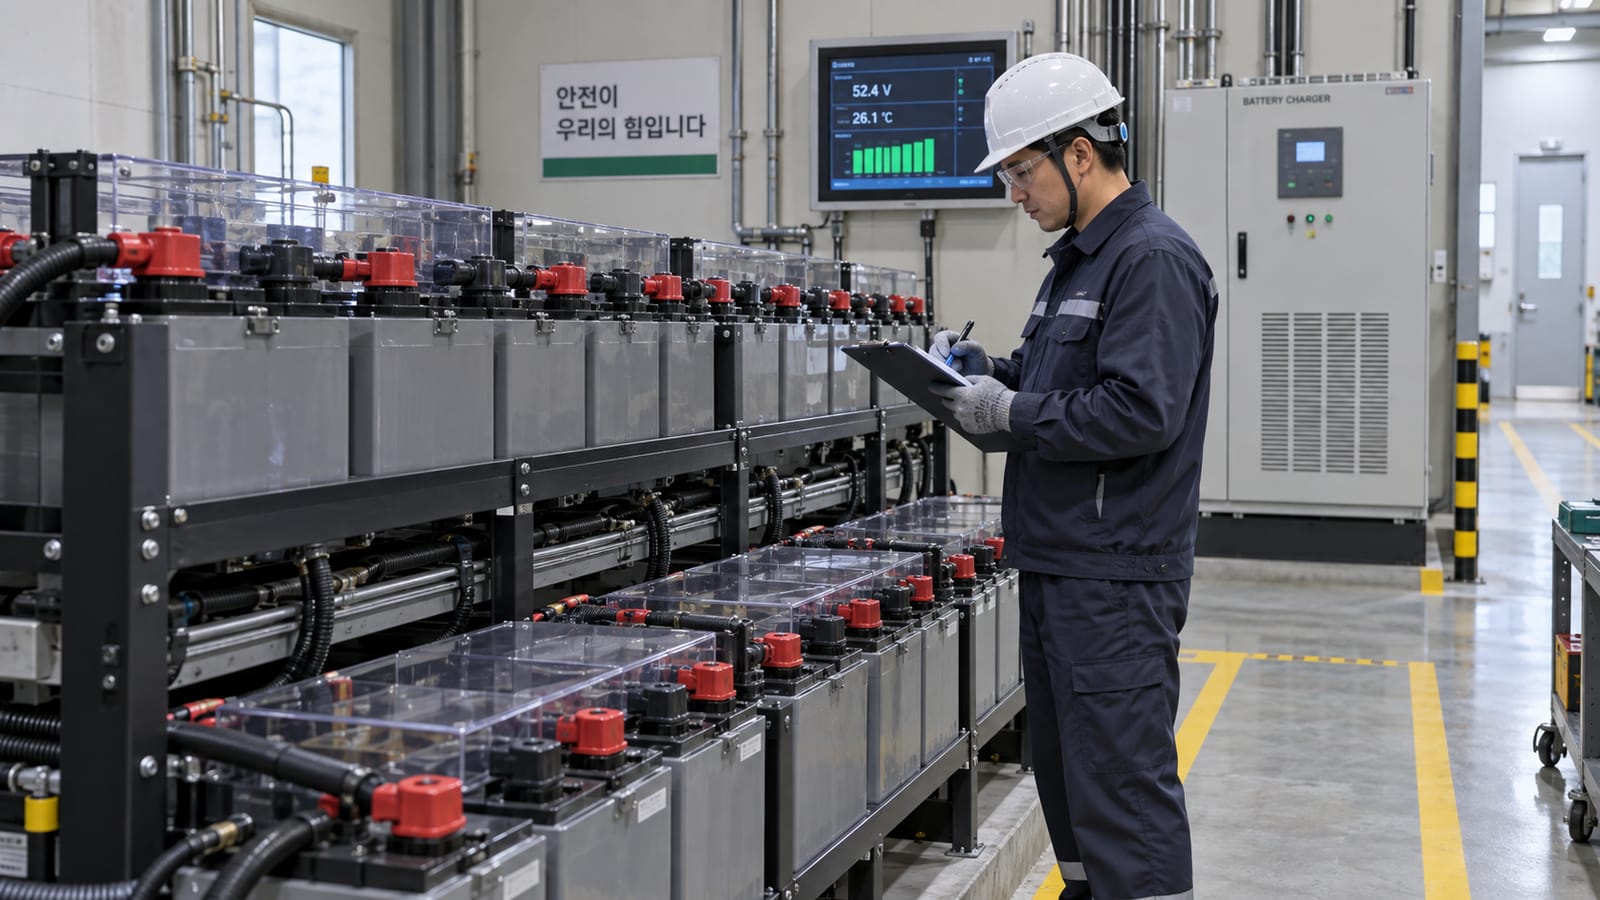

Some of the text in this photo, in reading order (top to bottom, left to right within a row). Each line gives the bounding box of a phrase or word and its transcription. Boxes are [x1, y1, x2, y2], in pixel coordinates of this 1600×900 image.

[556, 84, 618, 110] 안전이
[852, 83, 892, 98] 52.4 V
[1242, 94, 1331, 106] BATTERY CHARGER
[852, 112, 877, 124] 26.1
[556, 113, 706, 141] 우리의 힘입니다
